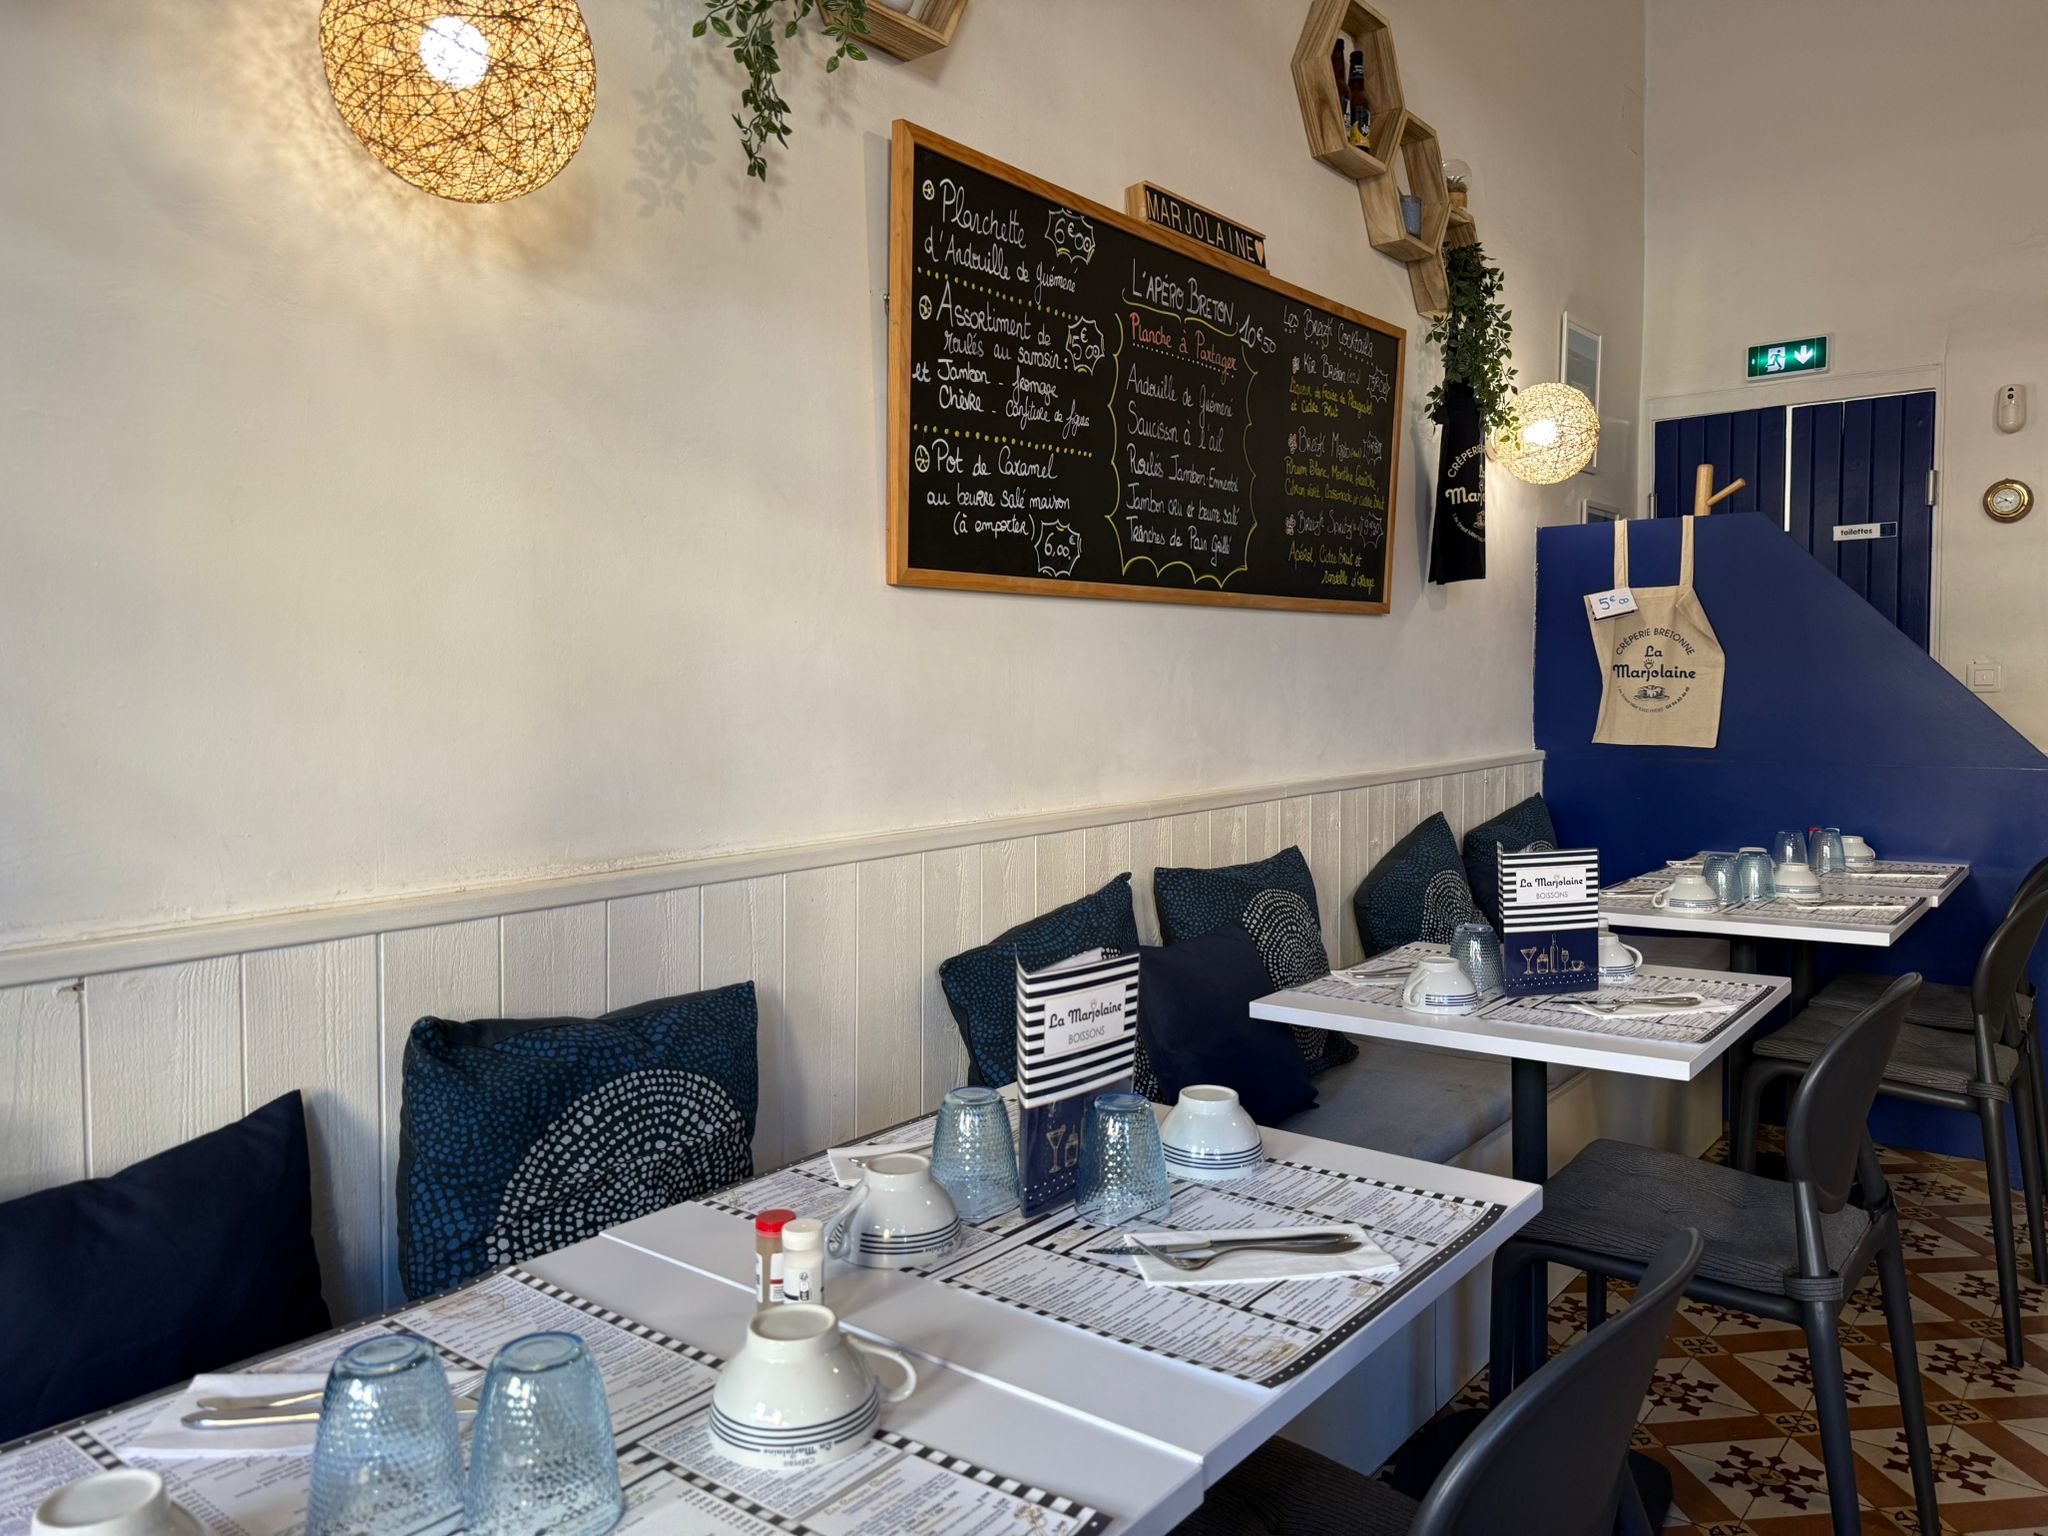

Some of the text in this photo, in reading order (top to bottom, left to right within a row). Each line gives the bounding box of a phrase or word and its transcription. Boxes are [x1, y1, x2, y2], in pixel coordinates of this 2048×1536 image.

[939, 178, 1026, 249] Planchette
[1146, 190, 1256, 262] MARJOLAINE
[1016, 260, 1030, 283] de
[936, 280, 1052, 346] Assortiment de
[1283, 304, 1299, 328] Les
[1129, 311, 1173, 349] Planche
[1178, 329, 1188, 354] à
[993, 346, 1012, 361] au
[936, 358, 991, 385] Jambon
[1126, 362, 1178, 402] Andouille
[1182, 390, 1194, 408] de
[1127, 400, 1179, 443] Saucisson
[1183, 419, 1192, 446] à
[931, 438, 1059, 480] Pot de Caramel
[926, 490, 950, 506] au
[1029, 489, 1071, 510] maison
[1126, 483, 1166, 514] Jambon
[1126, 515, 1166, 546] Tranches
[1169, 528, 1183, 547] de
[1187, 525, 1208, 552] Pain
[1840, 528, 1873, 536] toilettes
[1616, 627, 1695, 656] CRÊPERIE BRETONNE
[1644, 645, 1663, 658] La
[1612, 664, 1696, 682] Marjolaine
[1519, 876, 1584, 889] La Marjolaine
[1535, 891, 1569, 900] BOISSONS
[1048, 1002, 1123, 1029] La Marjolaine
[1068, 1025, 1106, 1046] BOISSONS
